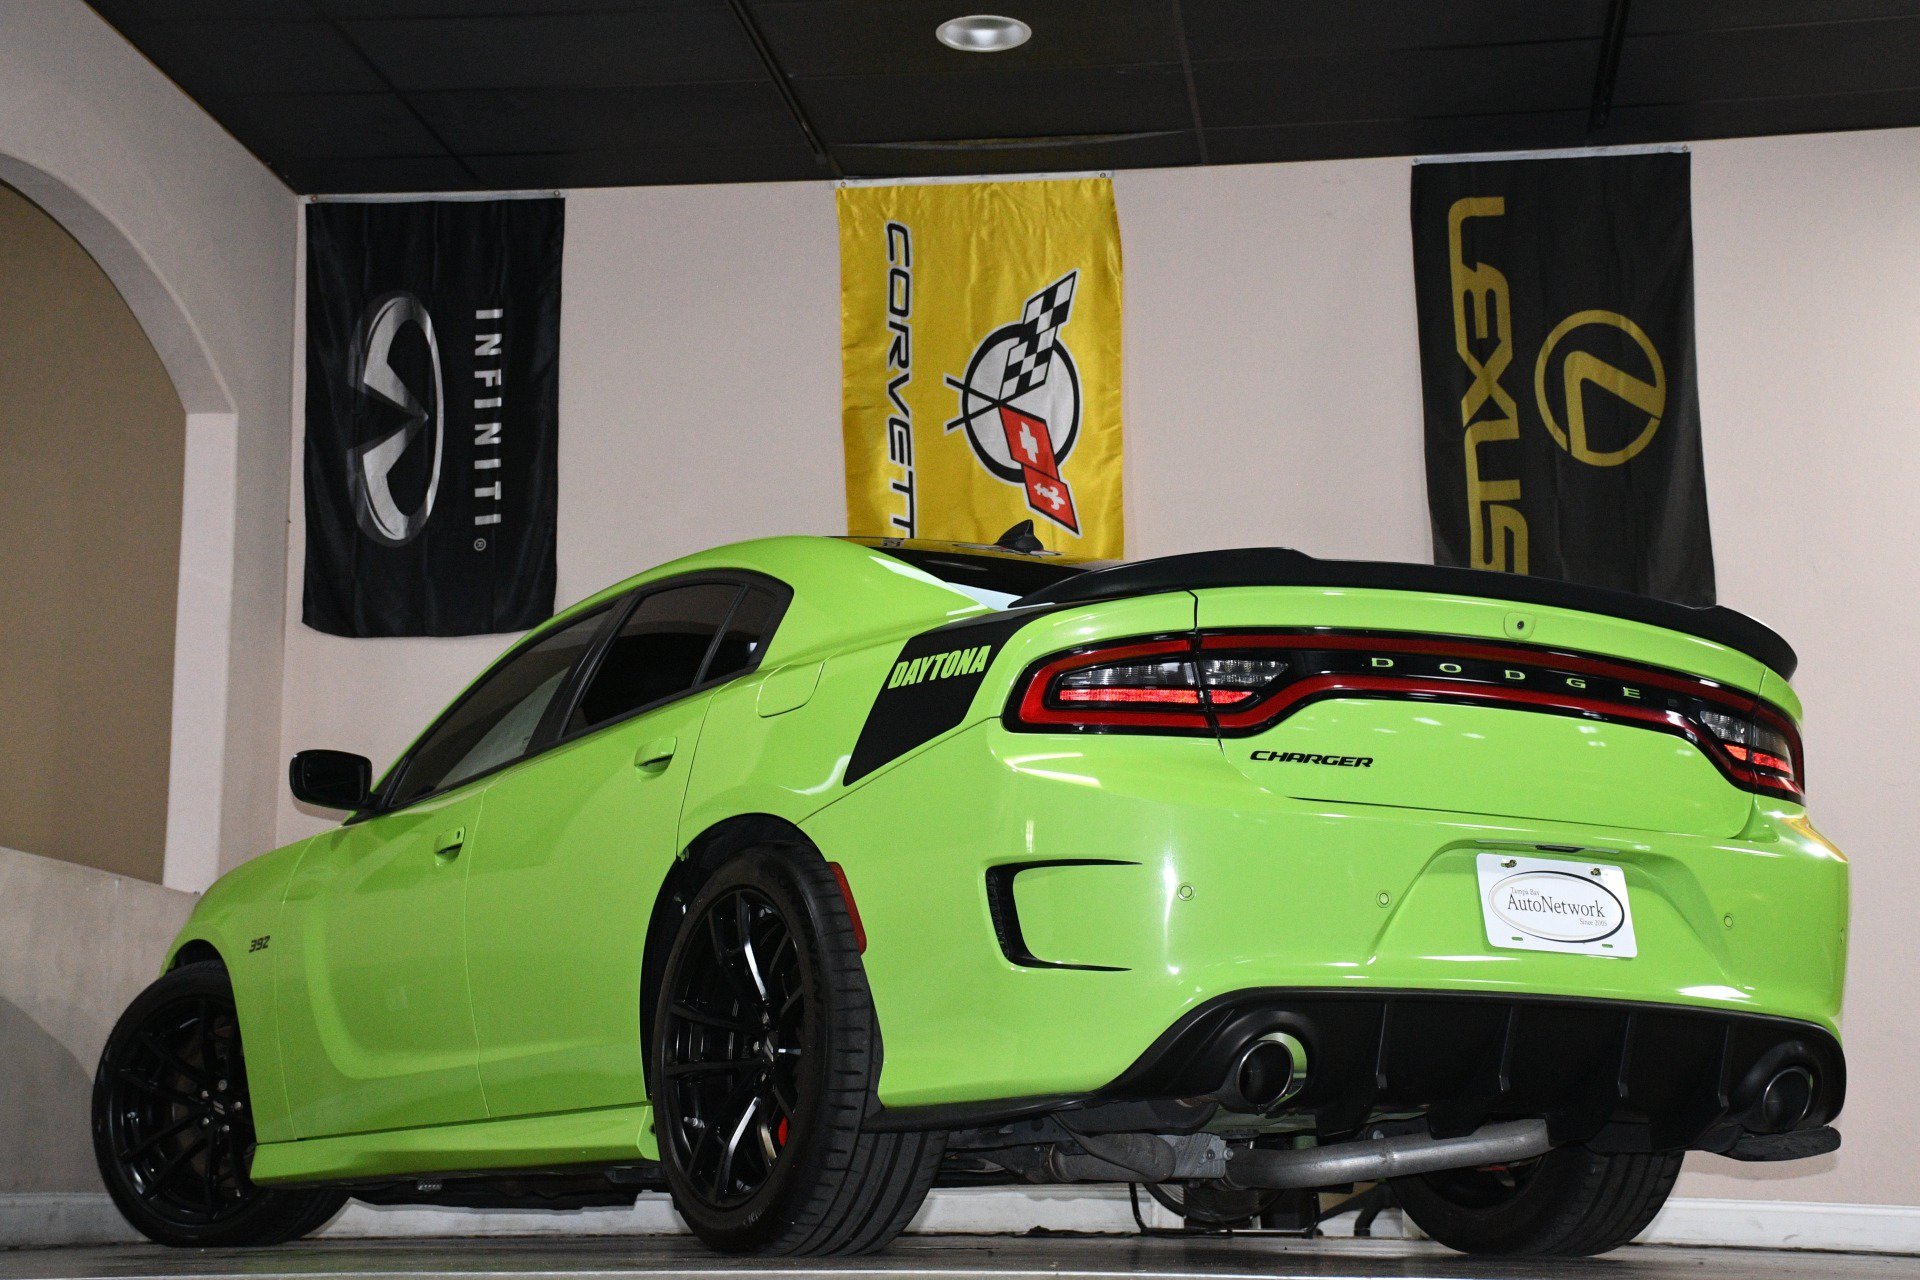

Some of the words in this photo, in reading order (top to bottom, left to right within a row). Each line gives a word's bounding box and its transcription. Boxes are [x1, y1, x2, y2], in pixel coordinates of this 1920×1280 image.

[886, 222, 916, 539] CORVETT
[1447, 196, 1530, 576] LEXUS
[474, 308, 503, 526] INFINITI
[887, 644, 992, 690] DAYTONA
[1371, 656, 1642, 699] DODGE
[1249, 750, 1374, 768] CHARGER
[1507, 894, 1606, 918] AutoNetwork
[1510, 886, 1529, 896] Tampa
[248, 934, 271, 953] 392
